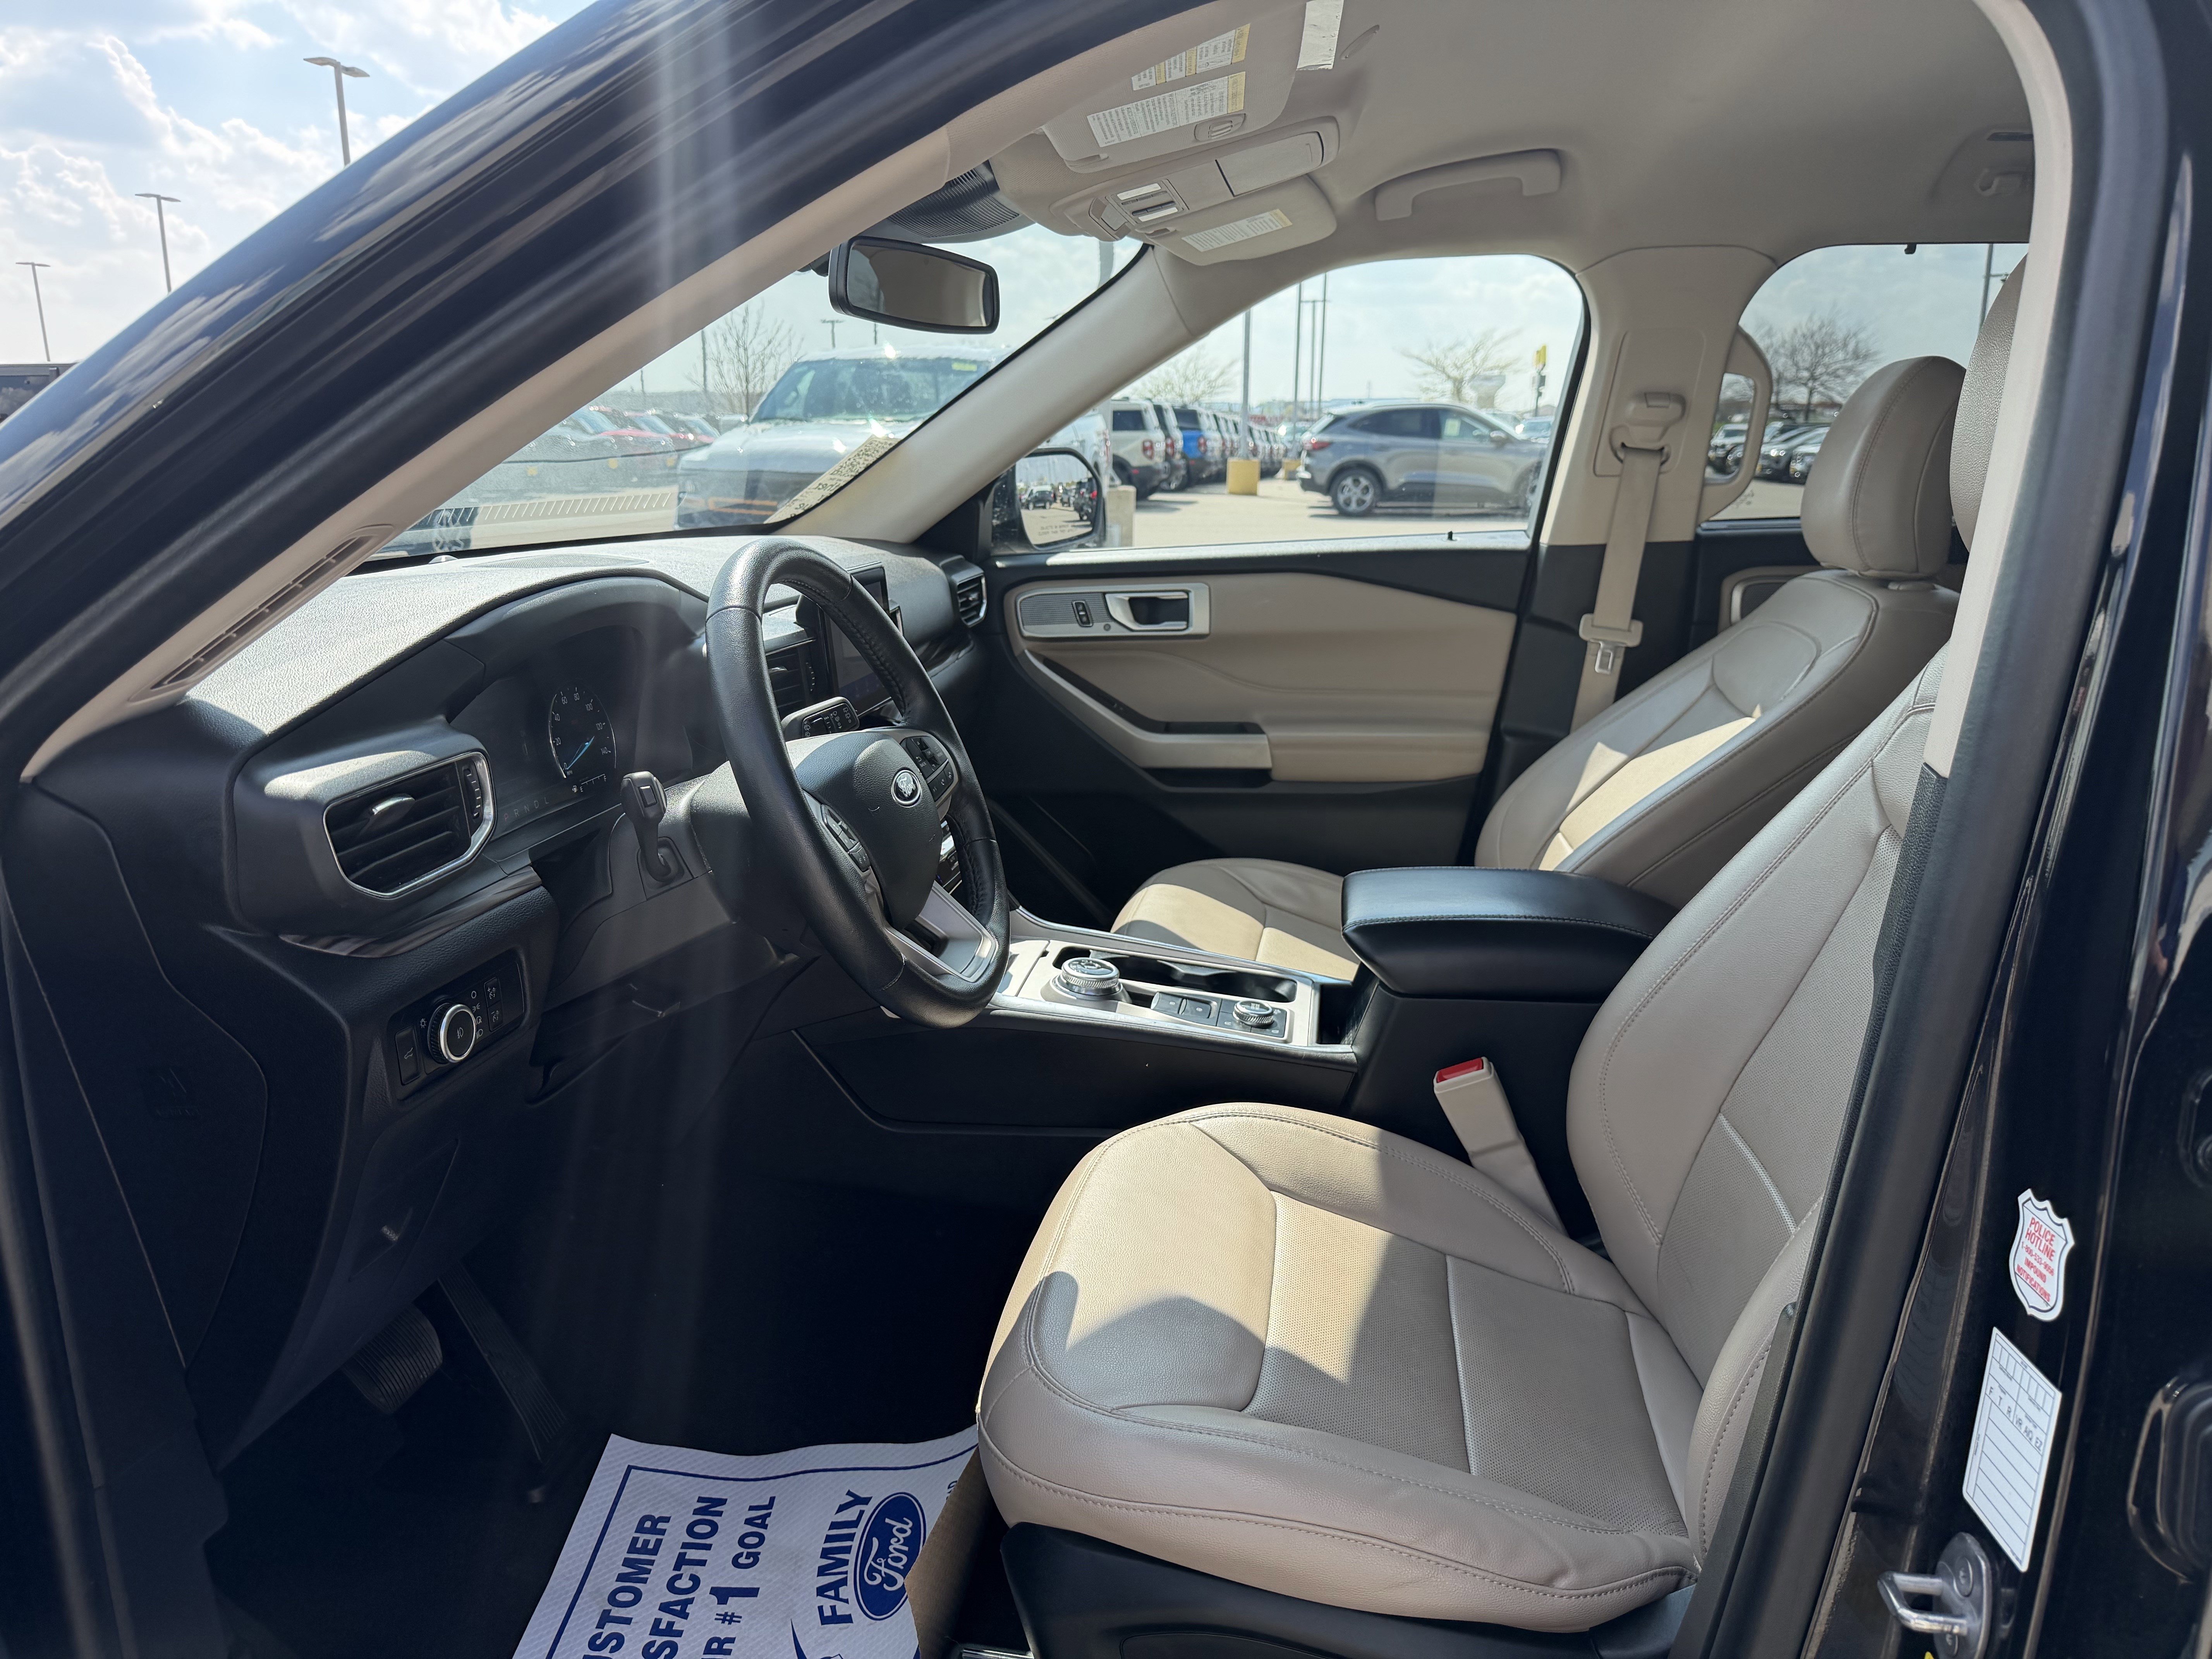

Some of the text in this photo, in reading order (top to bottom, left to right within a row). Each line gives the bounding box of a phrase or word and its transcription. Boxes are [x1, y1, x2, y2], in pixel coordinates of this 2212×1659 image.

[555, 737, 561, 745] 20
[514, 809, 519, 817] R
[524, 804, 530, 813] N
[534, 800, 539, 809] D
[2025, 1227, 2056, 1262] HOTLINE
[2029, 1216, 2056, 1247] POLICE
[2016, 1264, 2051, 1302] NOTIFICATIONS
[2024, 1257, 2047, 1283] IMPOUND
[1989, 1386, 1994, 1395] F
[1998, 1395, 2002, 1407] T
[2006, 1406, 2012, 1418] R
[732, 1496, 776, 1569] GOAL
[816, 1489, 873, 1626] FAMILY
[864, 1517, 913, 1591] Ford
[582, 1514, 672, 1659] STOMER
